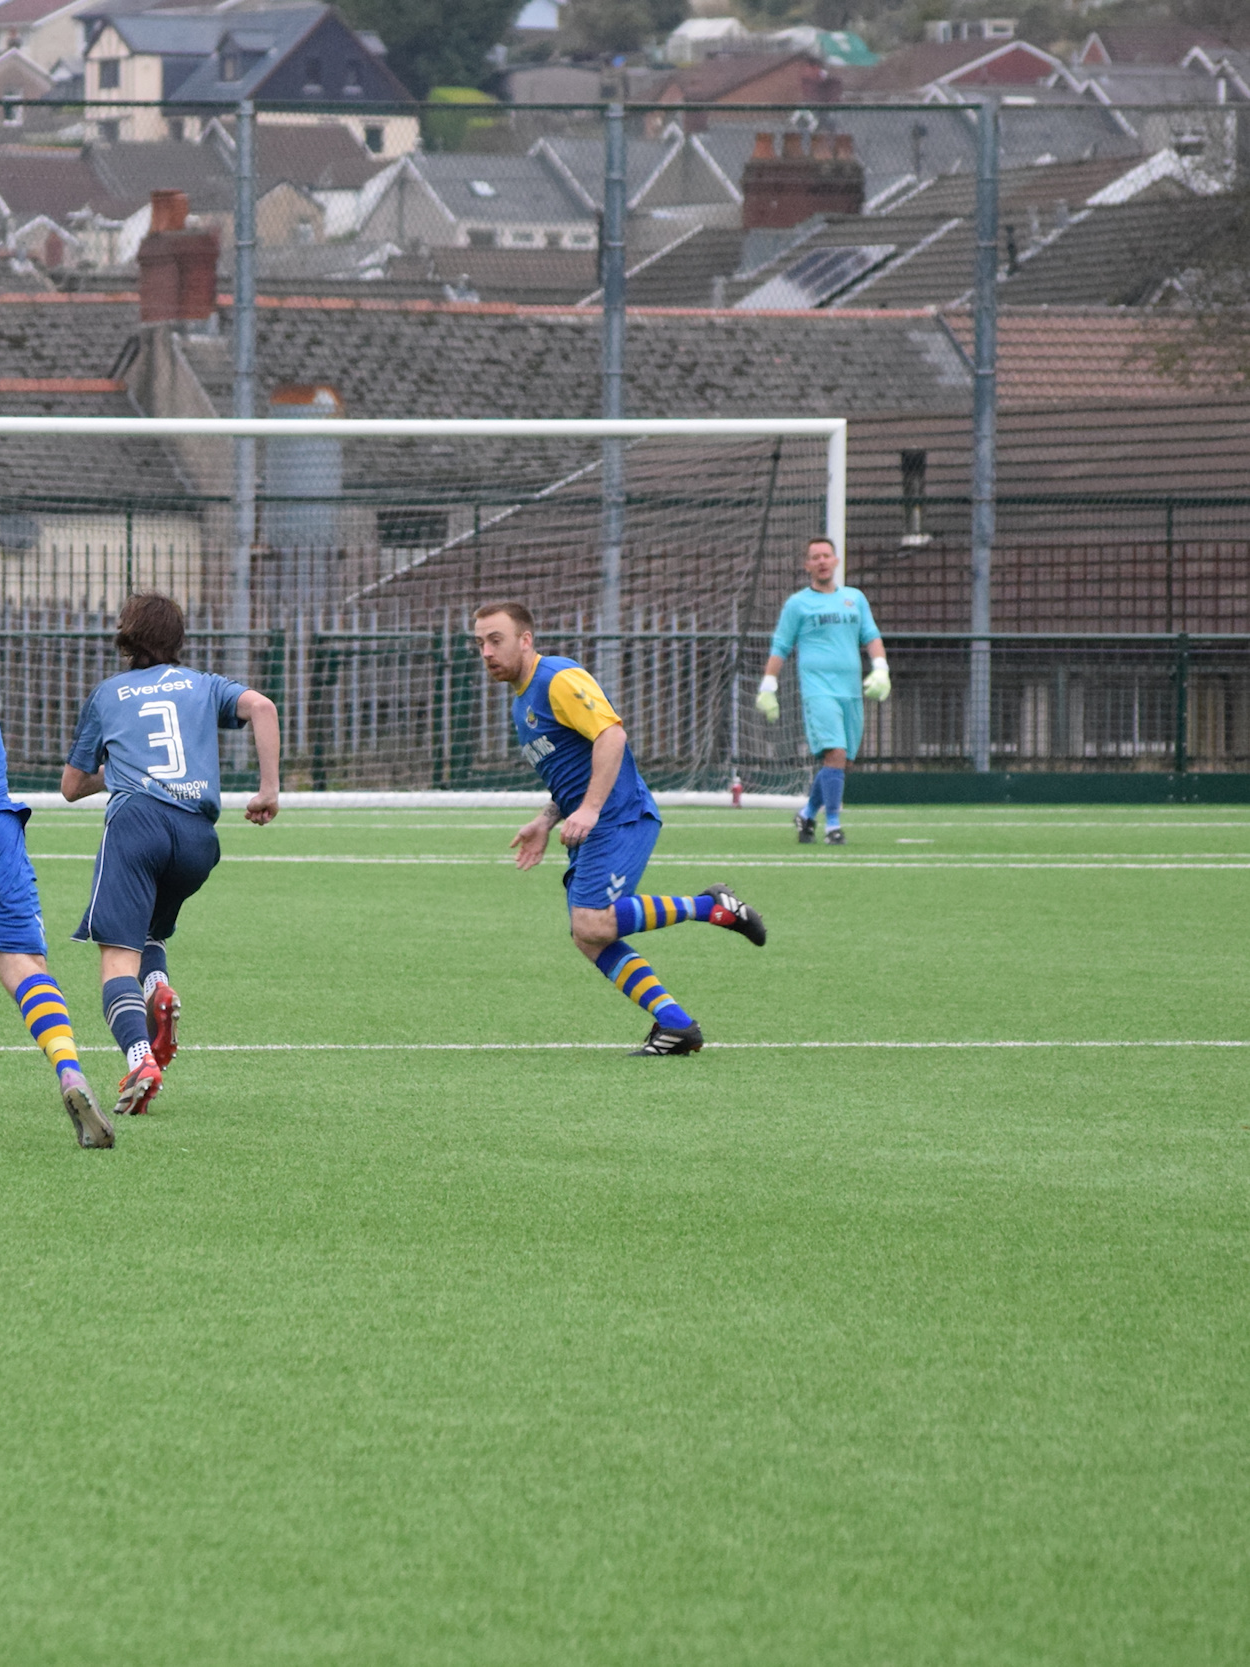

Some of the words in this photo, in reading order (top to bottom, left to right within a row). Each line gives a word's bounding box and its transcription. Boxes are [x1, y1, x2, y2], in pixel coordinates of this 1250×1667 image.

[116, 679, 194, 702] Everest
[138, 700, 187, 779] 3
[167, 780, 208, 793] WINDOW
